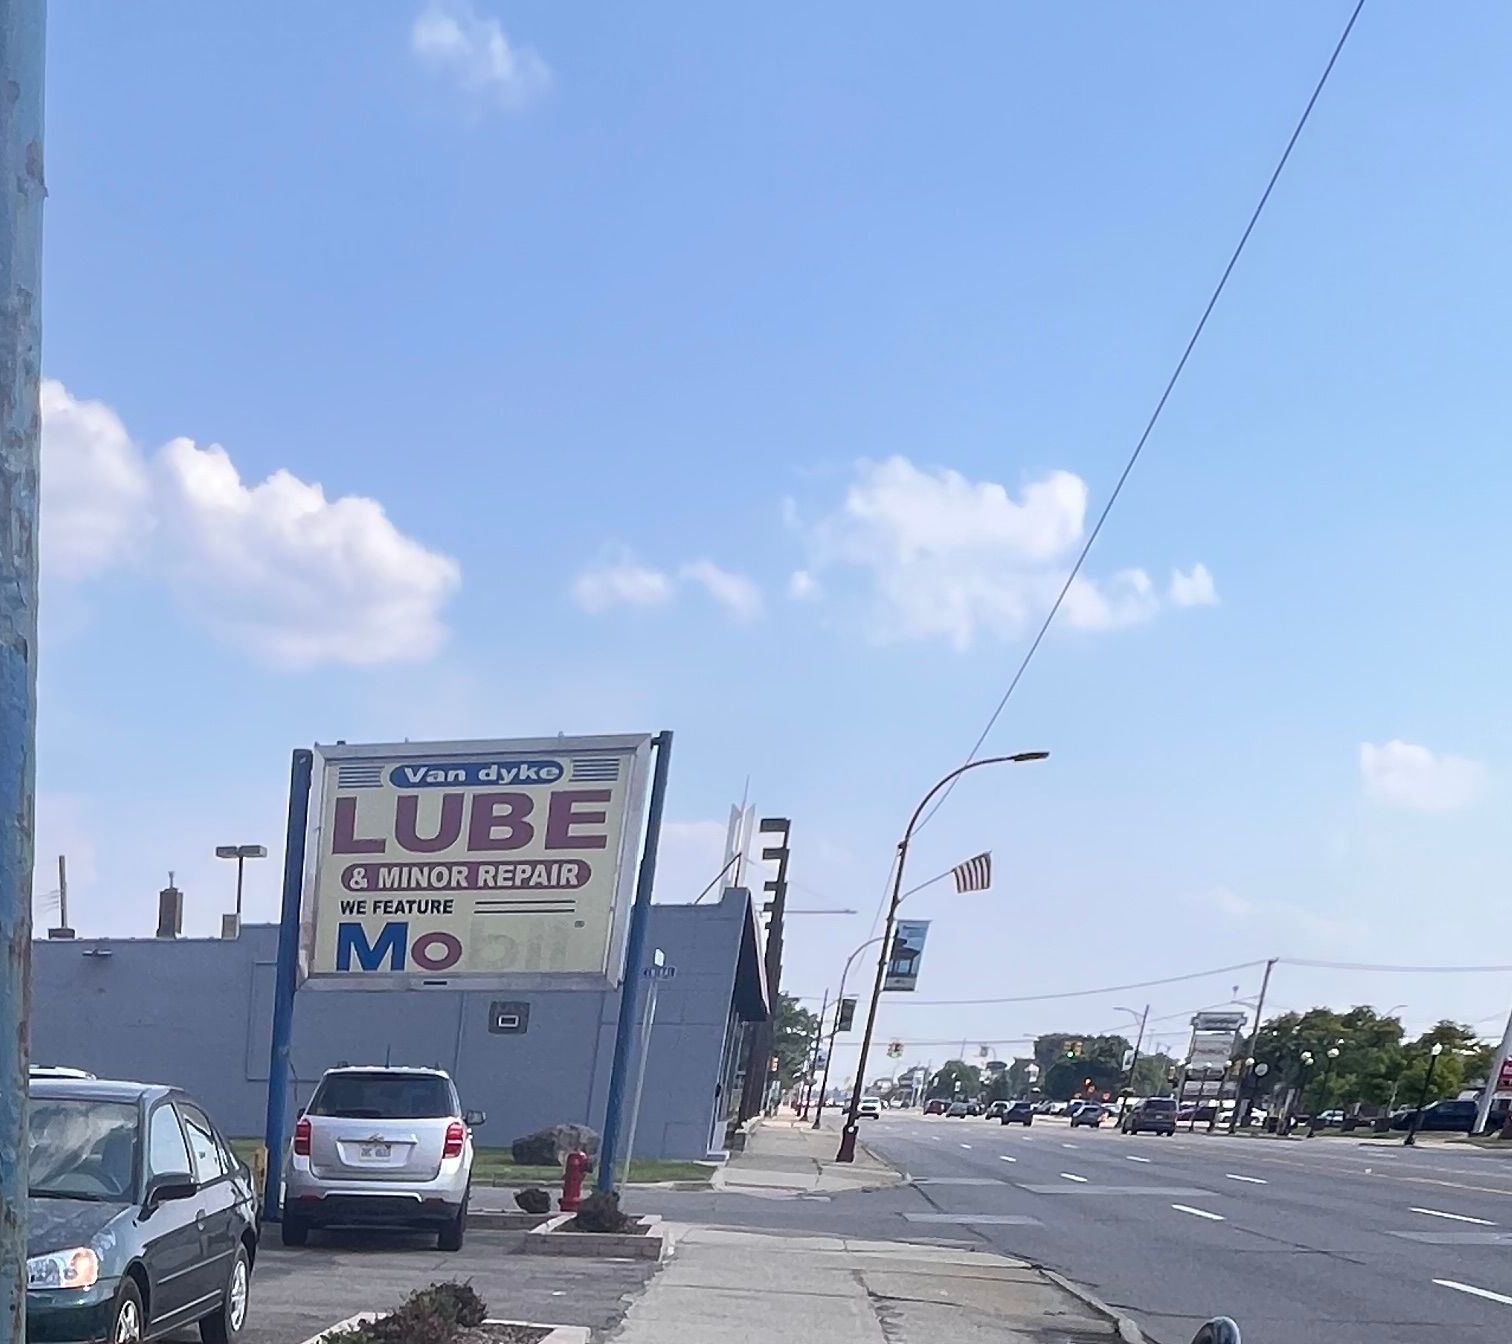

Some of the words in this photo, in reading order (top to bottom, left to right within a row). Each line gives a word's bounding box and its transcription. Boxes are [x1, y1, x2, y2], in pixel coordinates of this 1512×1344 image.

[405, 767, 466, 783] Van
[479, 765, 559, 784] dyke
[332, 789, 612, 854] LUBE
[349, 868, 367, 888] &
[378, 866, 468, 888] MINOR
[477, 863, 579, 886] REPAIR
[340, 901, 367, 914] WE
[373, 899, 454, 913] FEATURE
